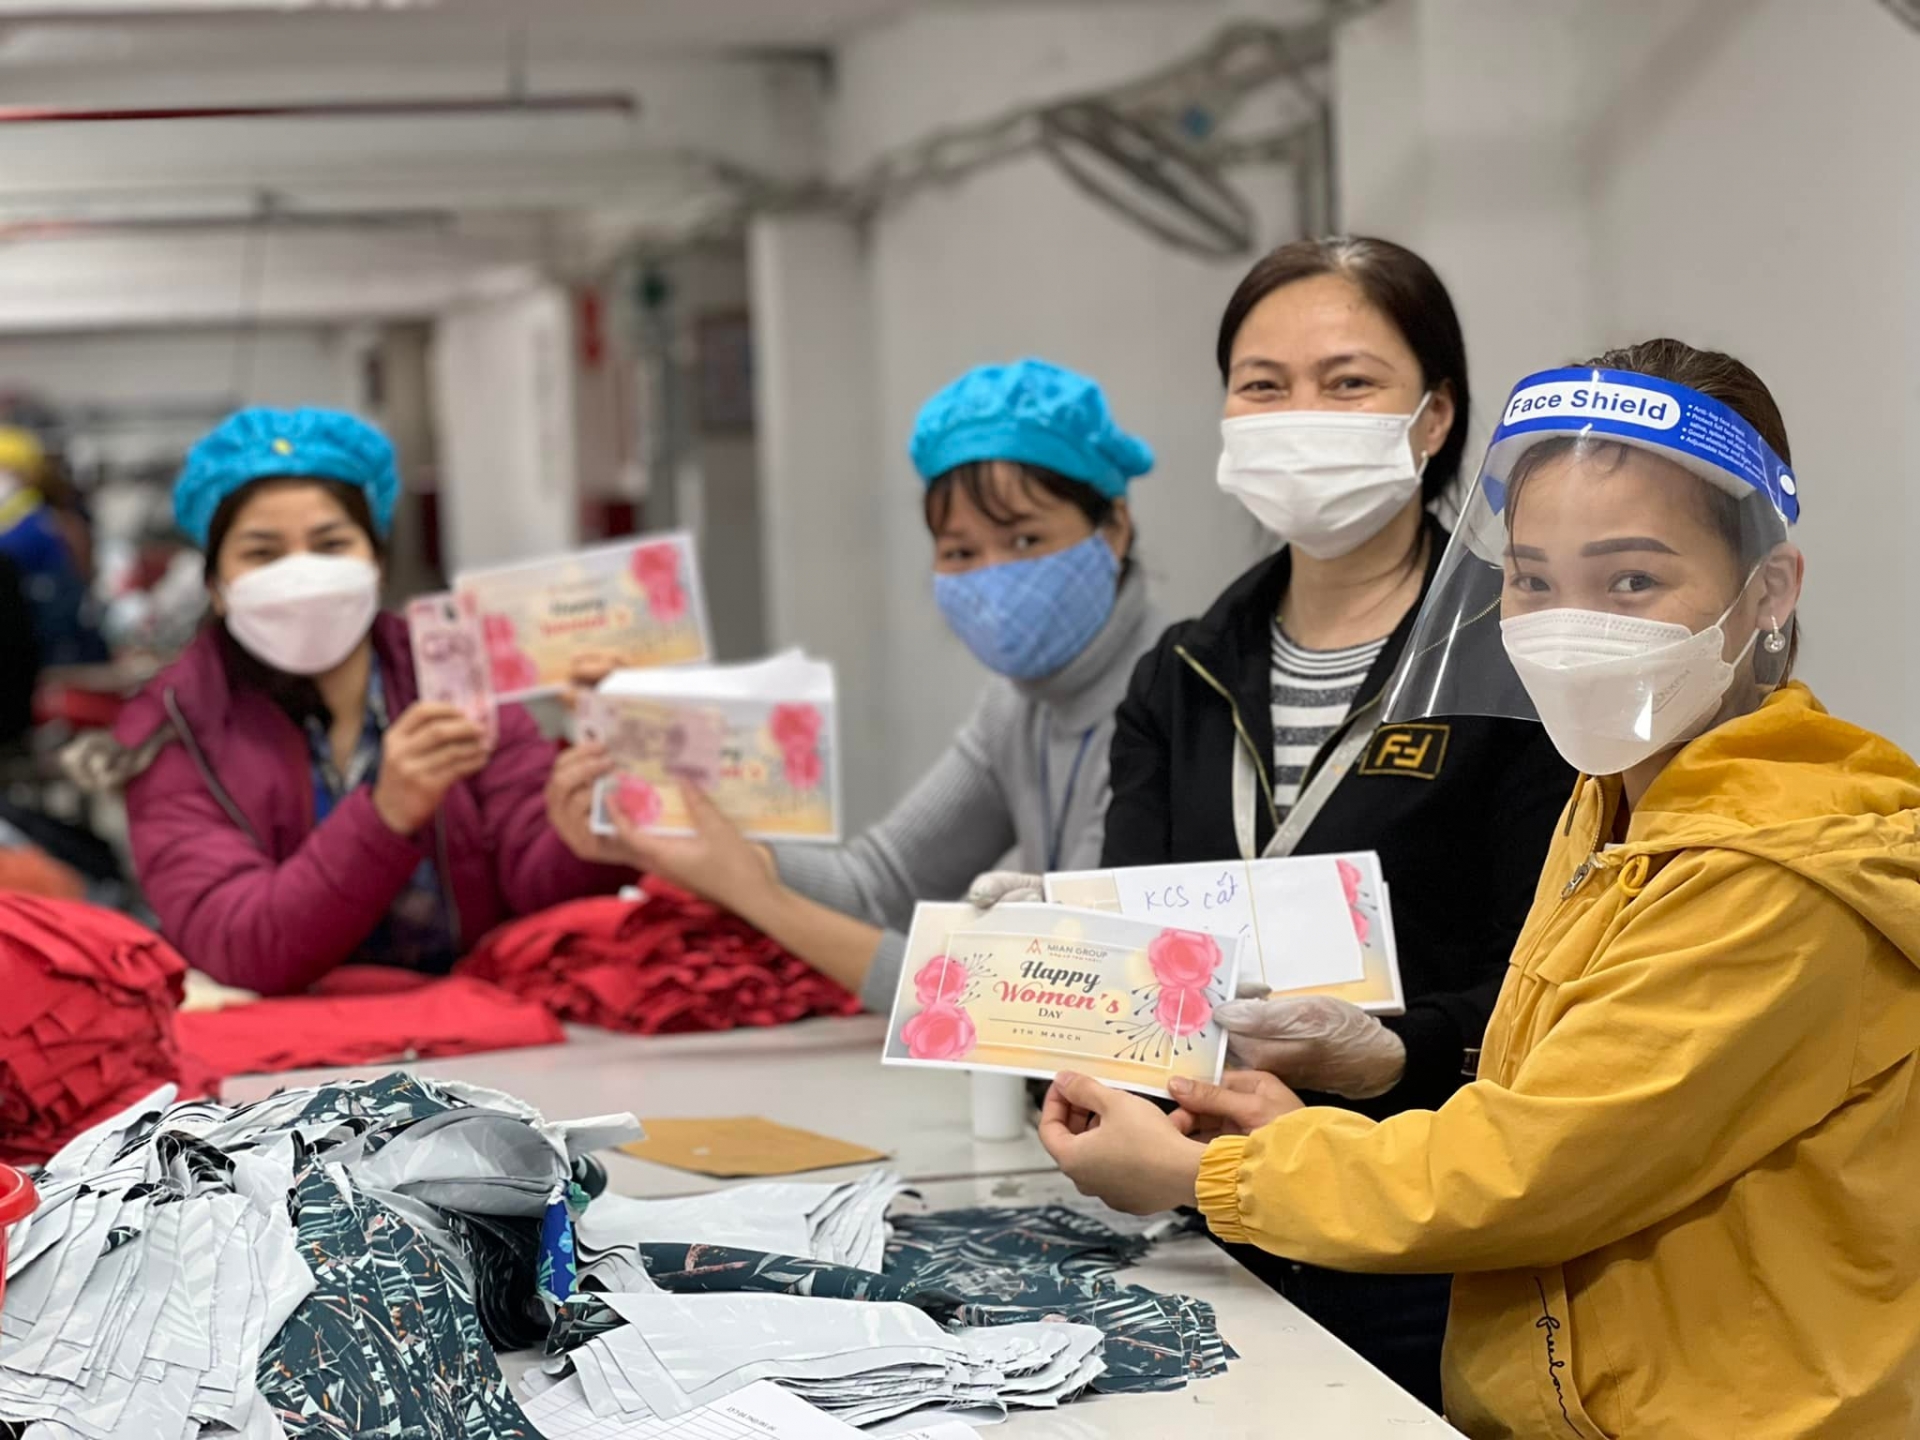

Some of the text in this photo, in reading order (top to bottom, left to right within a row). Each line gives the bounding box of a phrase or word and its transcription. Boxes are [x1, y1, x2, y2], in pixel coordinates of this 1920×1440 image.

[1509, 389, 1668, 421] Face Shield
[1145, 884, 1190, 911] KCS
[1047, 944, 1074, 954] MIAN
[1075, 947, 1108, 959] GROUP
[1020, 960, 1102, 993] Happy
[993, 980, 1120, 1014] Women's
[1038, 1007, 1063, 1019] DAY
[1040, 1030, 1082, 1041] MARCH
